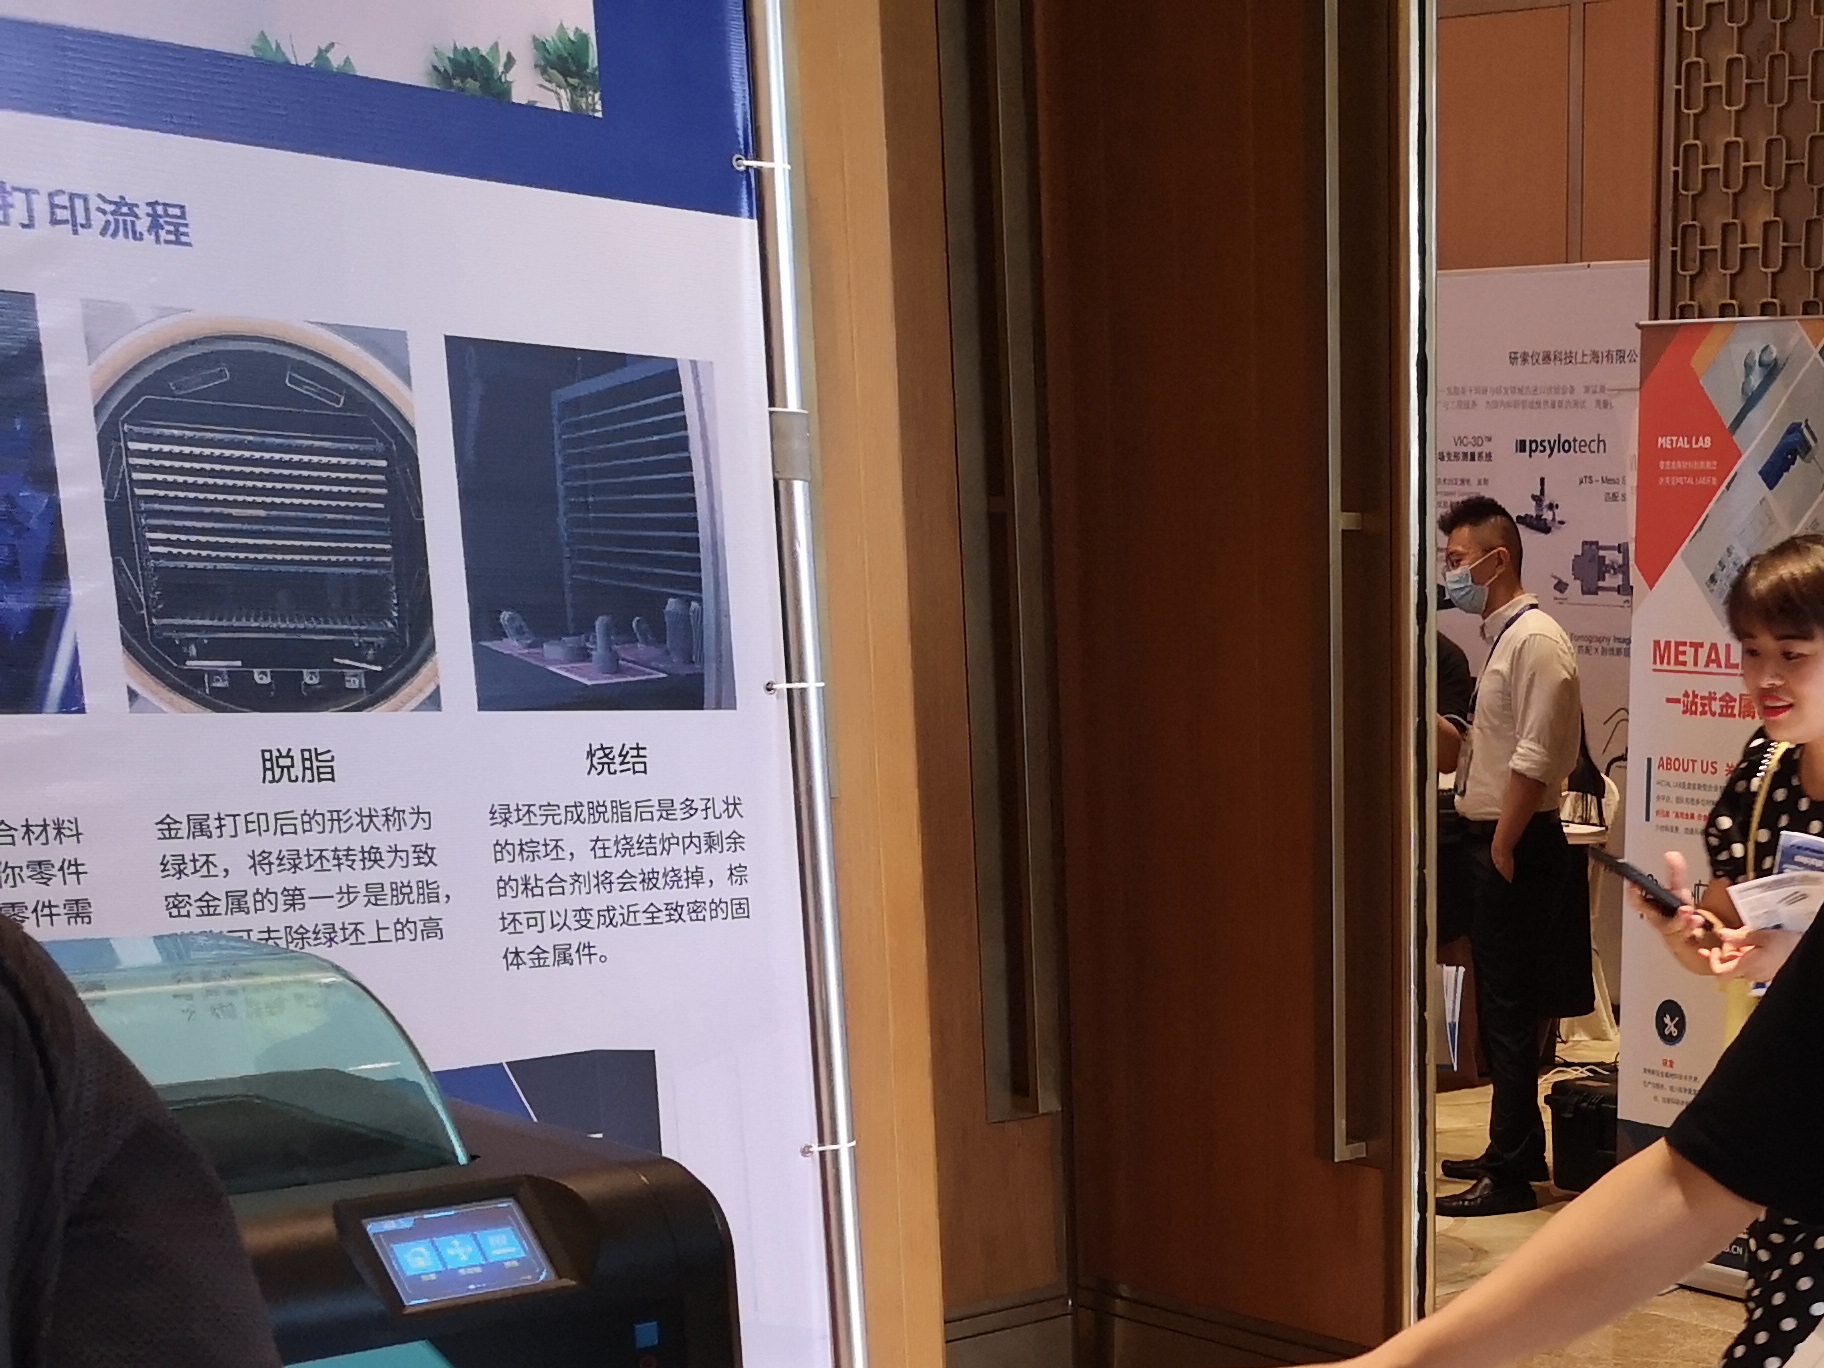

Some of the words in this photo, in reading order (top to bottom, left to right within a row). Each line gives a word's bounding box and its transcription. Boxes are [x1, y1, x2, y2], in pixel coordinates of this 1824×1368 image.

[0, 180, 193, 247] 打印流程
[1529, 433, 1607, 458] psylotech
[1658, 436, 1689, 449] METAL
[1692, 436, 1712, 448] LAB
[1652, 639, 1740, 670] METAL
[1665, 689, 1756, 720] 一站式金属
[260, 747, 337, 785] 脱脂
[586, 742, 648, 776] 烧结
[1657, 756, 1698, 773] ABOUT
[1701, 759, 1718, 775] US
[154, 805, 432, 842] 金属打印后的形状称为
[488, 795, 744, 828] 绿坯完成脱脂后是多孔状
[160, 842, 439, 880] 绿坯，将绿坯转换为致
[492, 829, 746, 864] 的棕坯，在烧结炉内剩余
[496, 863, 749, 900] 的粘合剂将会被烧掉，棕
[499, 896, 751, 935] 坯可以变成近全致密的固
[502, 941, 608, 971] 体金属件。
